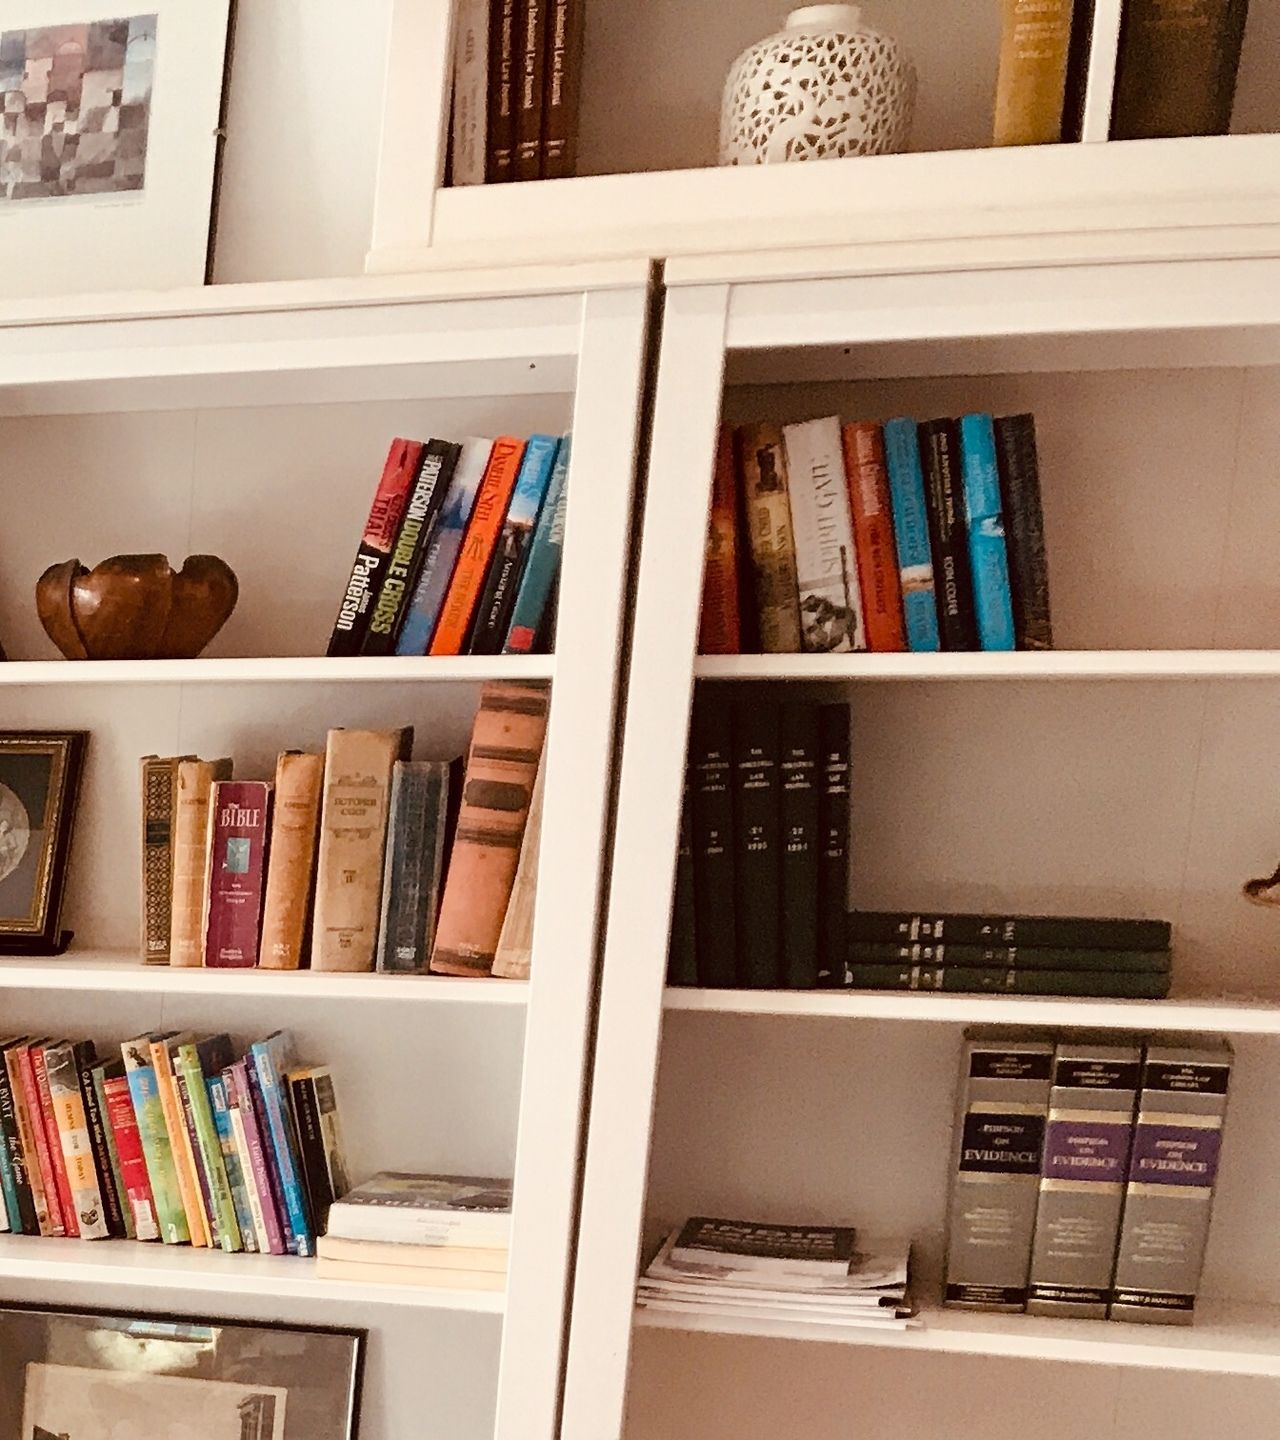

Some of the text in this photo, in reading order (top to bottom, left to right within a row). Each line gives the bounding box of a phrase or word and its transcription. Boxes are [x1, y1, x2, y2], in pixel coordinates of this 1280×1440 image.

[939, 431, 949, 452] AND
[941, 453, 952, 494] ANOTHER
[363, 493, 391, 541] TRIAL
[368, 458, 442, 636] PATTERSON DOUBLE CROSS
[335, 552, 378, 632] Patterson
[943, 555, 957, 615] EOIN COLFER
[220, 809, 260, 828] BIBLE
[88, 1107, 98, 1123] Too
[96, 1144, 108, 1170] DAVID
[74, 1156, 85, 1181] TODAY
[251, 1145, 262, 1166] Little
[964, 1149, 1037, 1163] EVIDENCE
[1052, 1155, 1119, 1168] EVIDENCE
[1140, 1158, 1207, 1172] EVIDENCE
[256, 1166, 269, 1197] Princess
